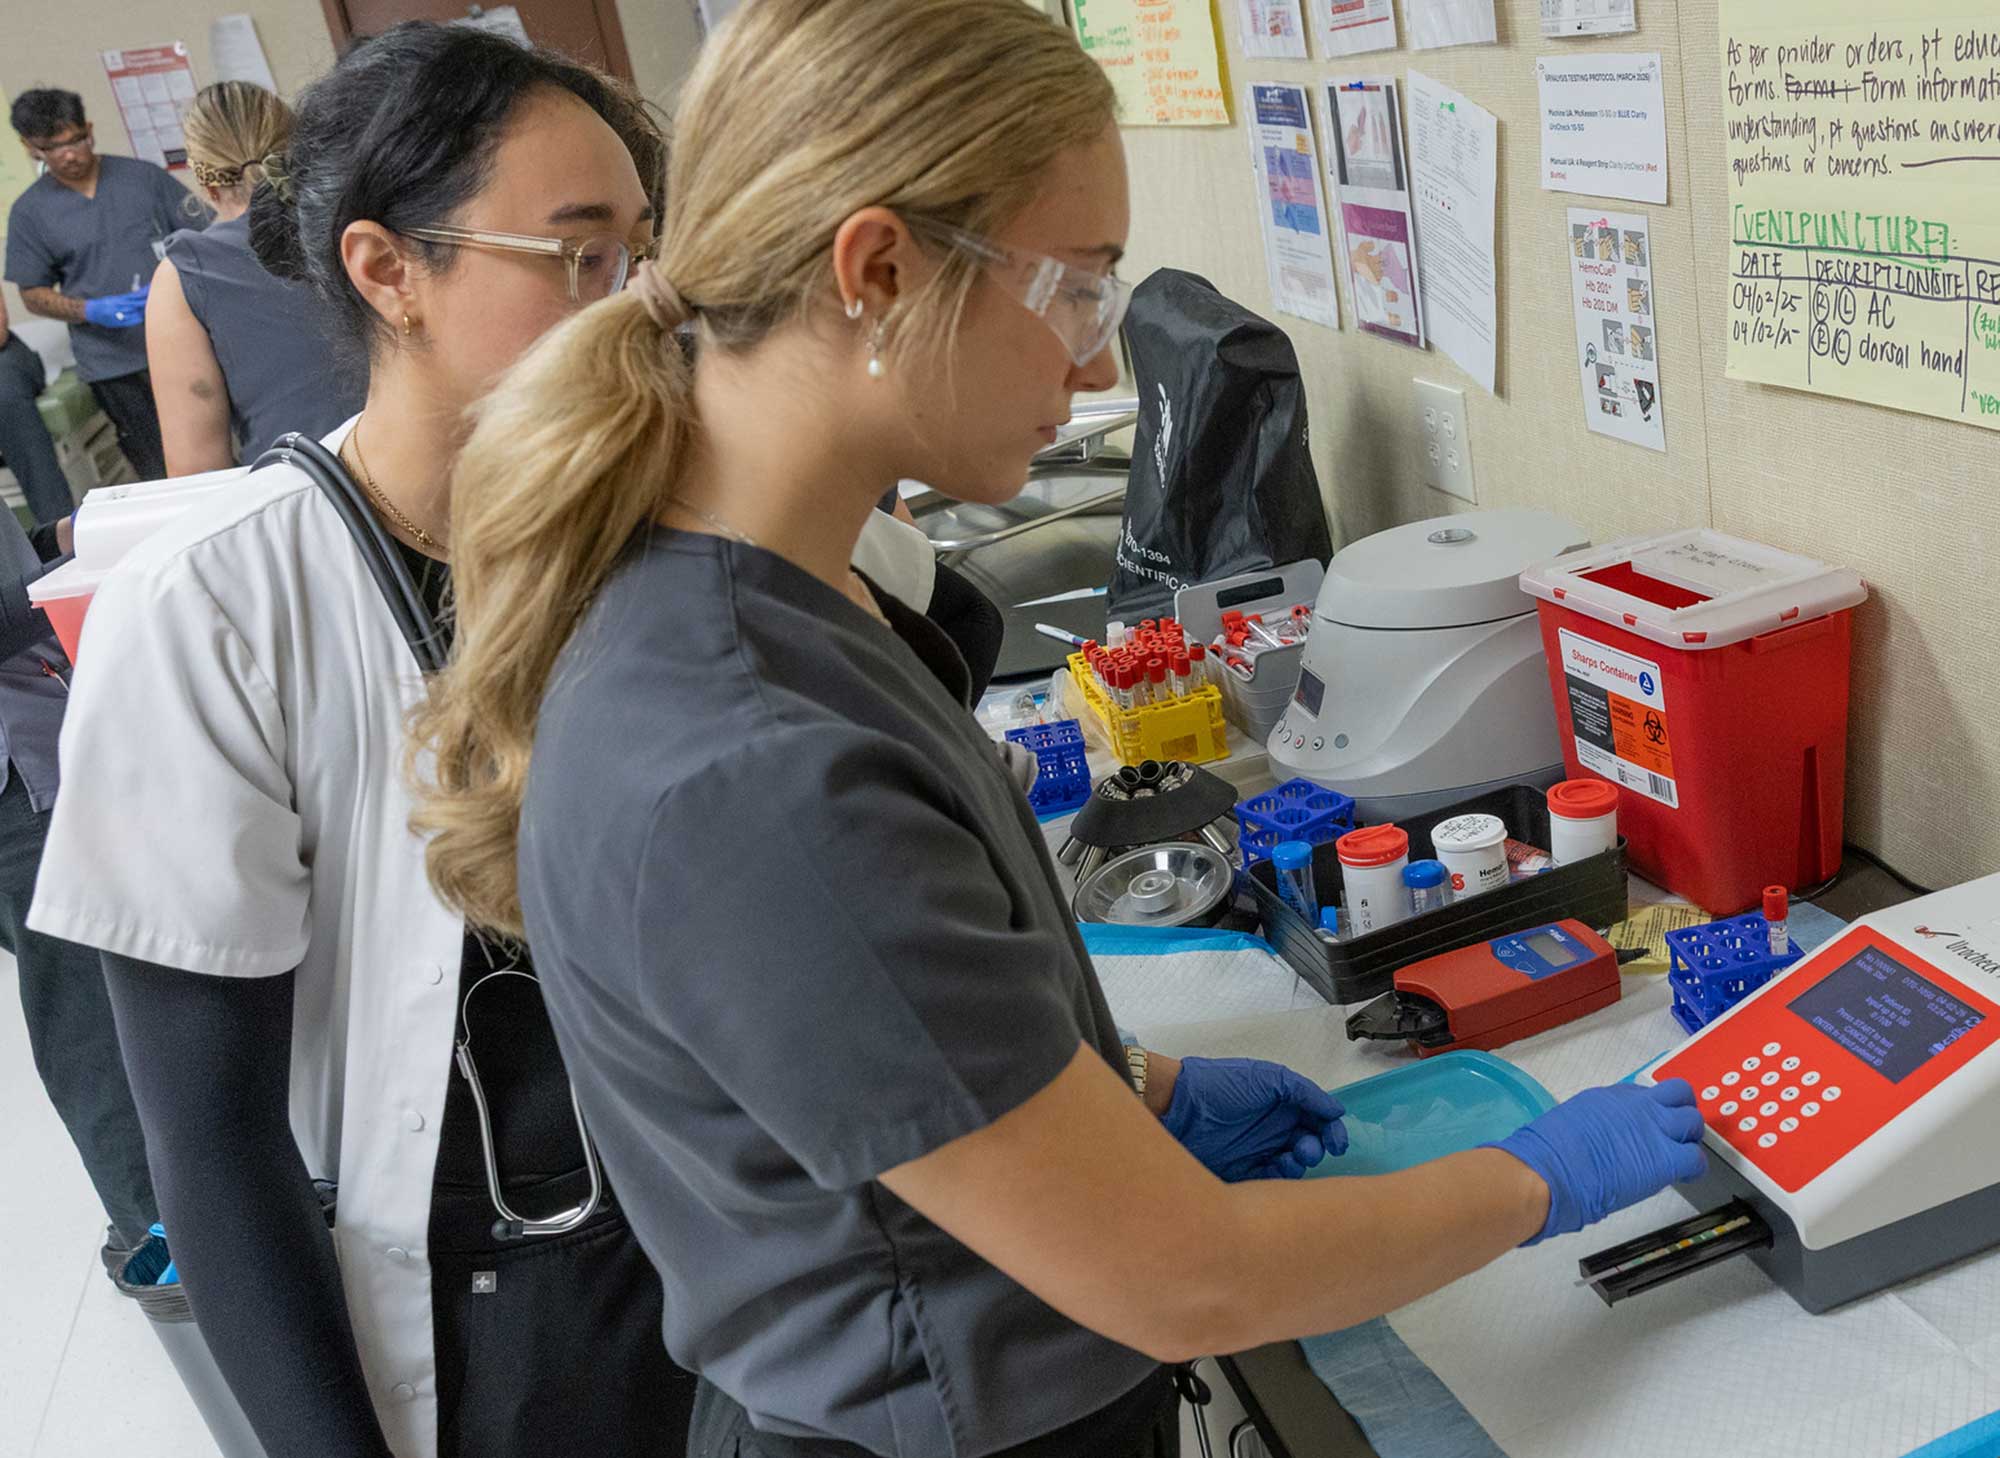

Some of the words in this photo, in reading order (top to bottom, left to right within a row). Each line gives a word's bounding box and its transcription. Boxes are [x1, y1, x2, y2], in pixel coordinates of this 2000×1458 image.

[1921, 28, 1943, 76] pt
[1954, 29, 2000, 62] educ
[1930, 119, 2000, 143] answer
[1741, 250, 1783, 277] DATE
[1585, 280, 1596, 292] Hb
[1582, 296, 1593, 309] Hb
[1606, 301, 1619, 314] DM
[1867, 291, 1896, 329] AC
[1859, 333, 1910, 369] dorsal
[1920, 341, 1963, 378] hand
[1572, 649, 1598, 669] Sharps
[1599, 660, 1638, 684] Container
